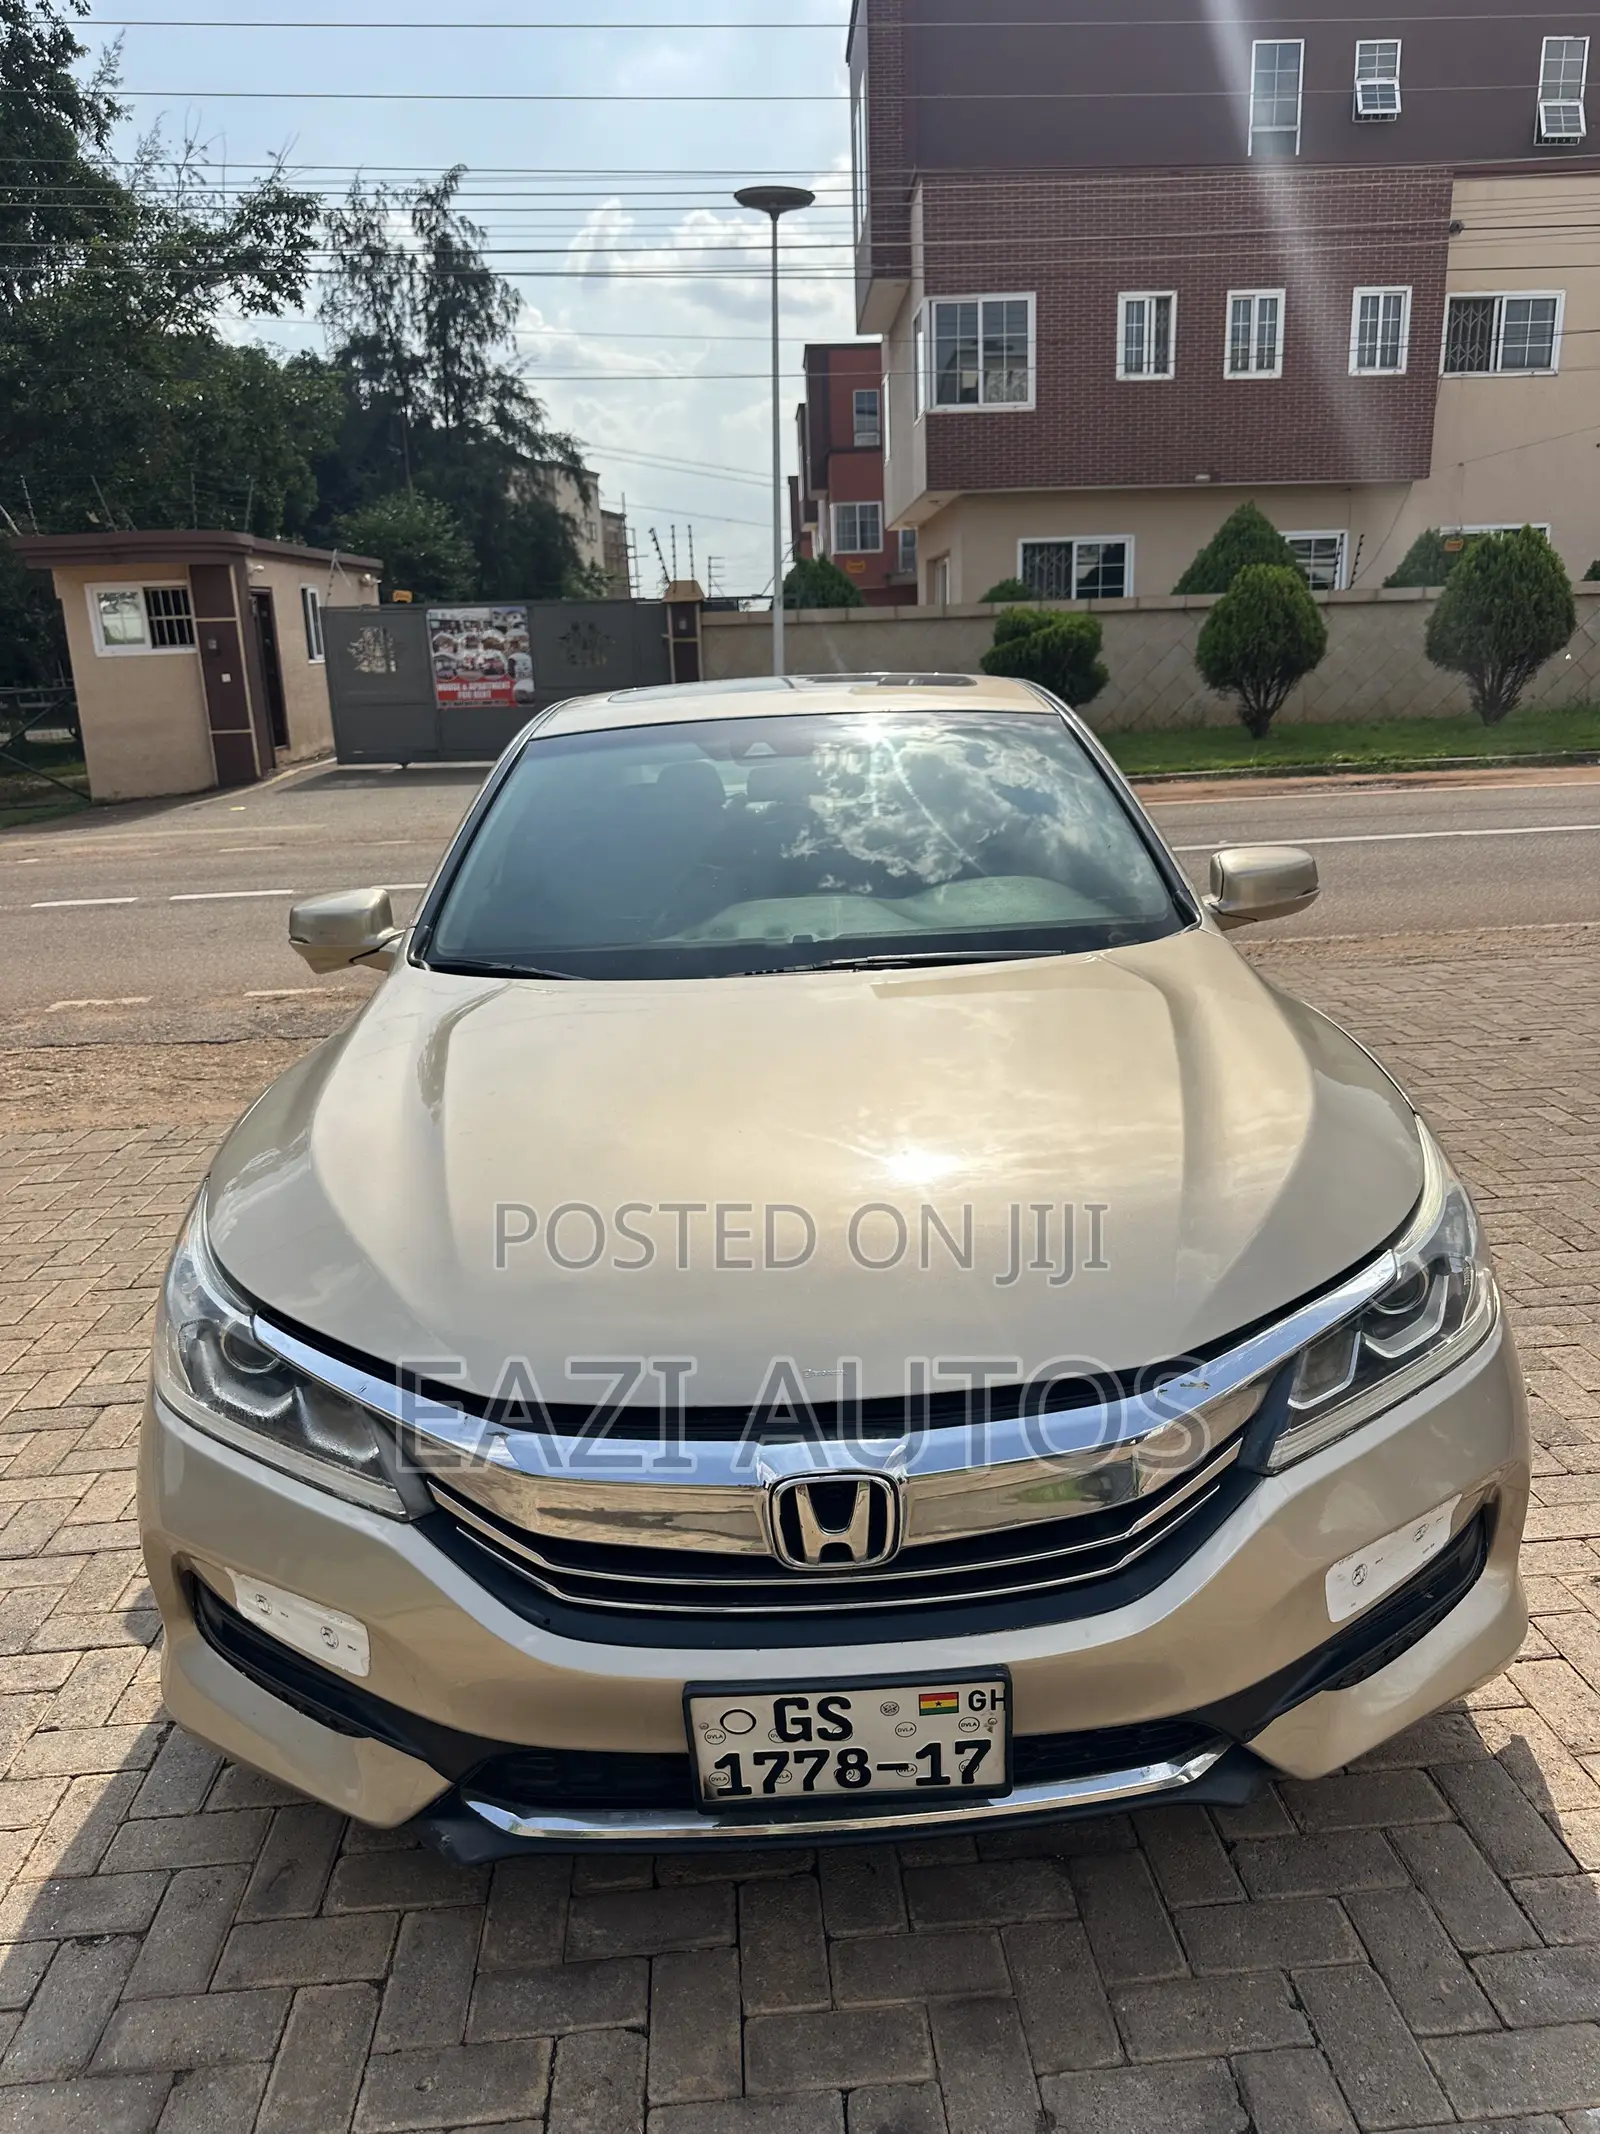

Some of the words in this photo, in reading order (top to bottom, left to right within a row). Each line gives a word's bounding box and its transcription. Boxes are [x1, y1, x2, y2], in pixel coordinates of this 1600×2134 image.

[773, 1695, 854, 1742] GS
[968, 1688, 1006, 1712] GH
[714, 1738, 992, 1797] 1778-17
